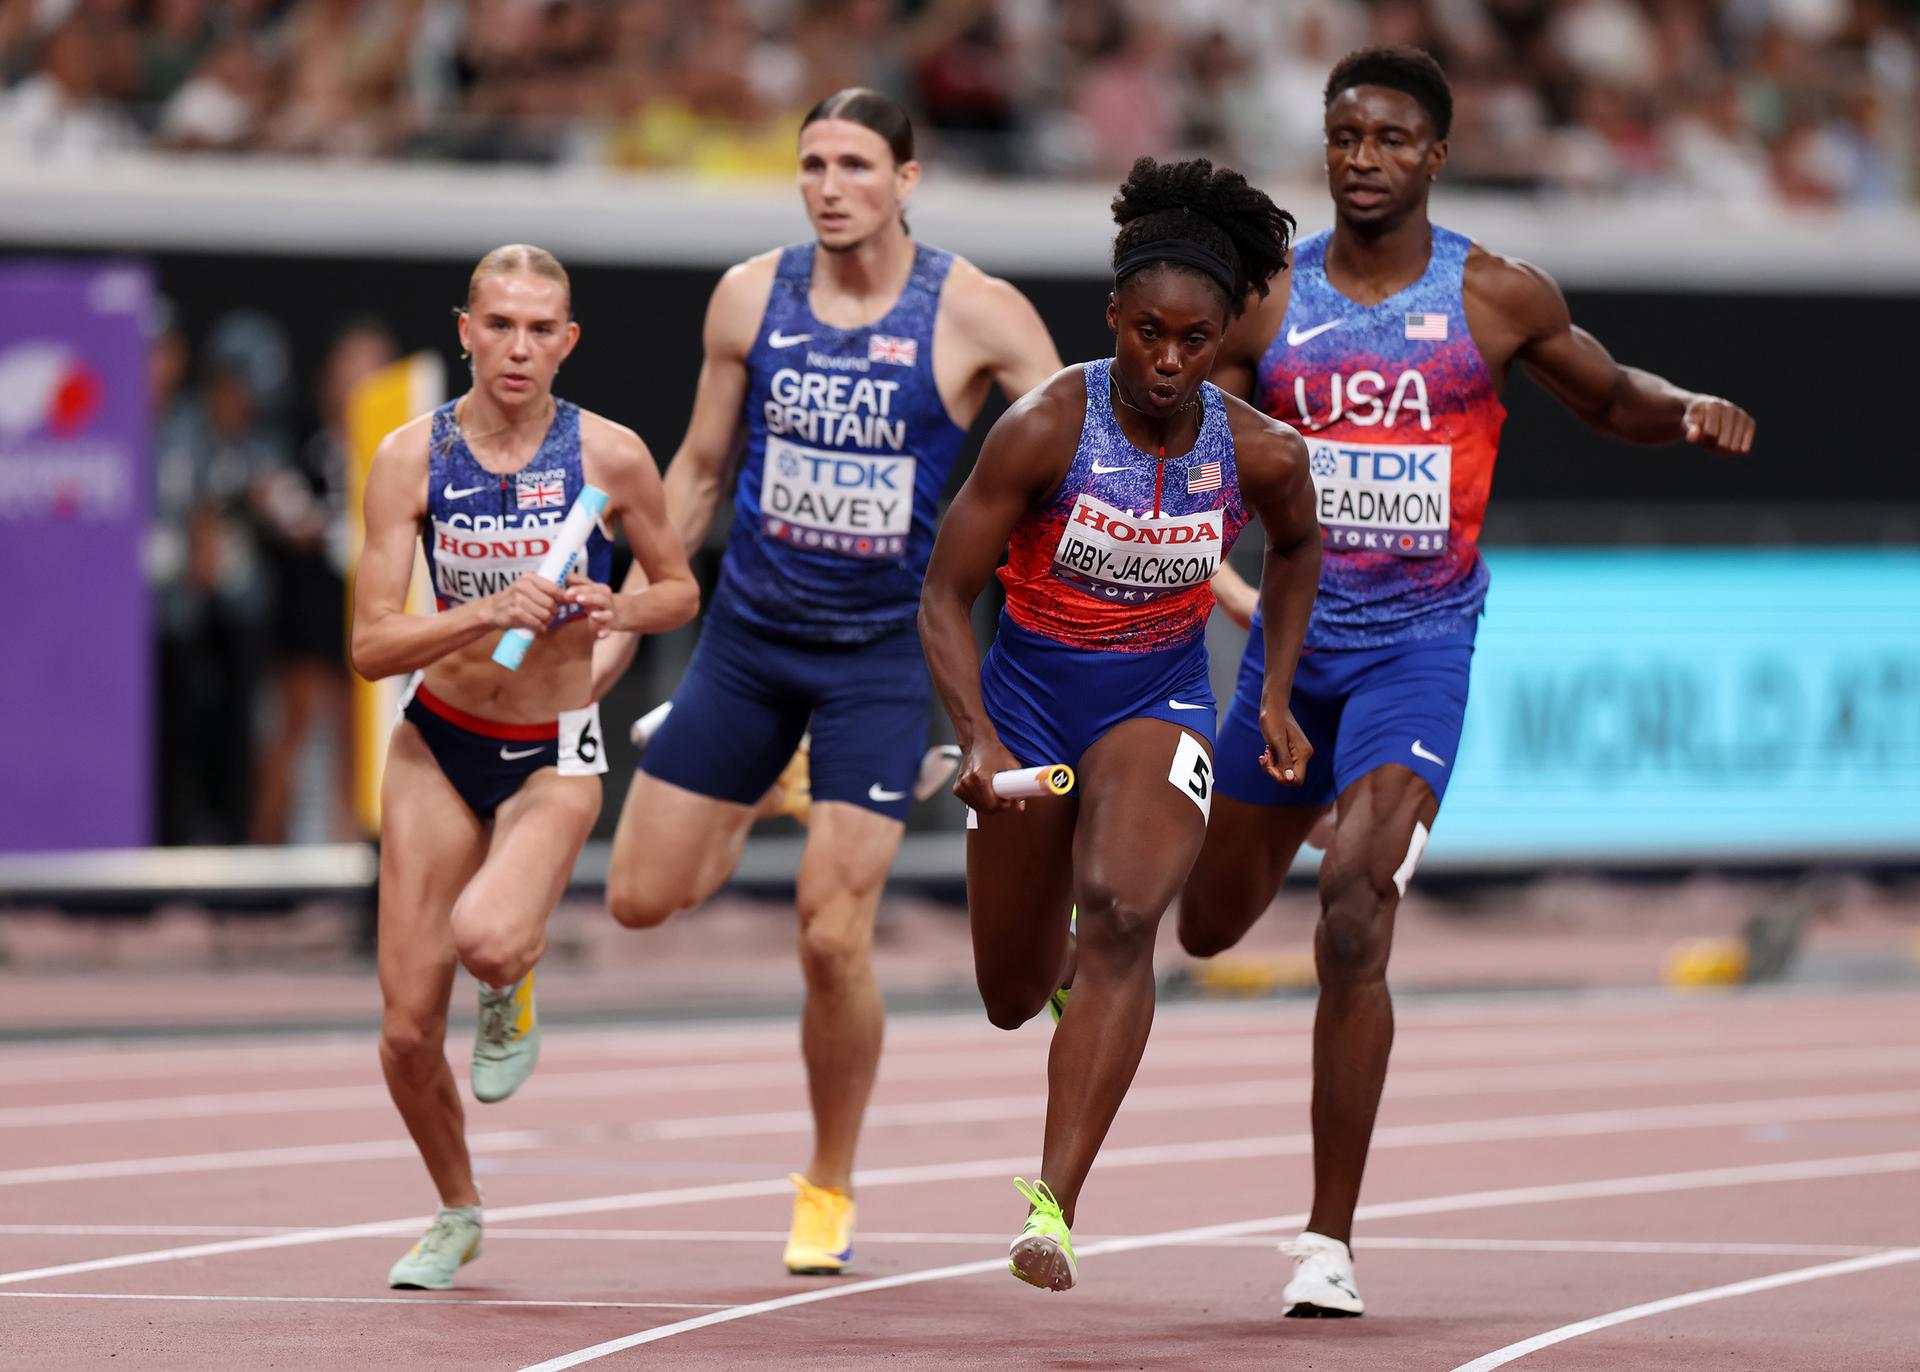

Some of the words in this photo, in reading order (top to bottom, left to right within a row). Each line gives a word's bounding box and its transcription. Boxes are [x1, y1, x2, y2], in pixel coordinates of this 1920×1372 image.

[770, 368, 900, 417] GREAT
[1294, 369, 1432, 431] USA
[764, 400, 906, 450] BRITAIN
[802, 455, 898, 490] TDK
[1339, 449, 1437, 482] TDK
[772, 484, 899, 528] DAVEY
[1073, 504, 1220, 545] HONDA
[1320, 488, 1442, 525] EADMON
[439, 533, 557, 560] HOND
[1060, 537, 1215, 586] IRBY-JACKSON
[1090, 582, 1170, 602] TOKY
[576, 717, 598, 764] 6
[1188, 754, 1210, 801] 5
